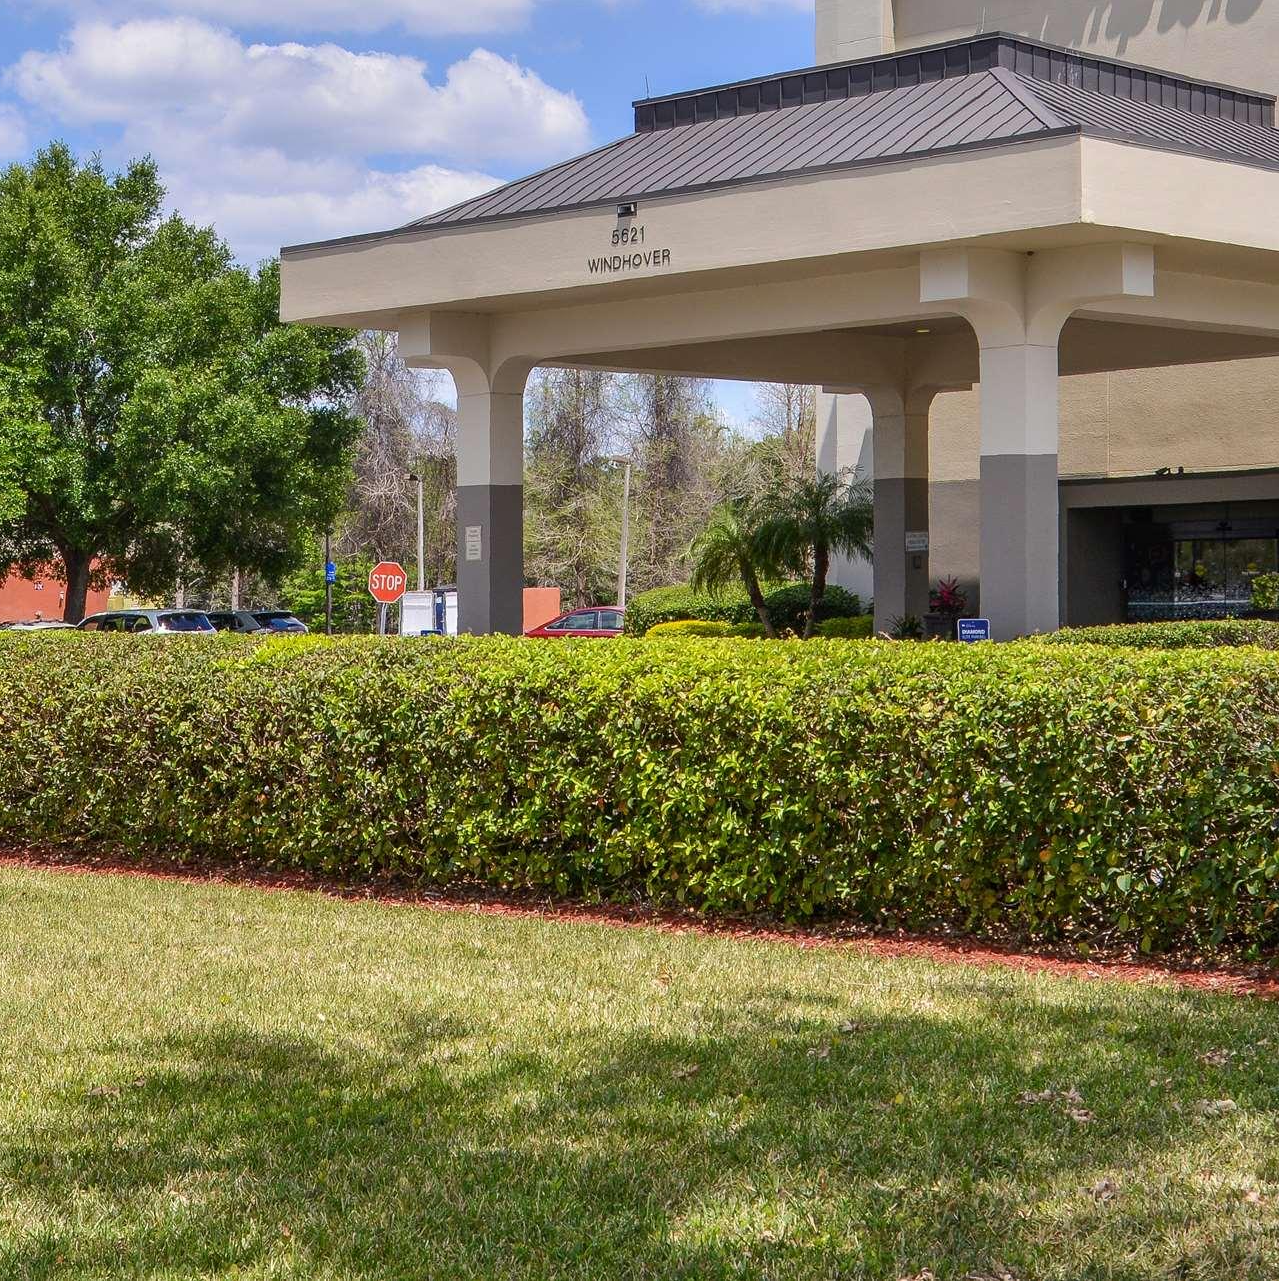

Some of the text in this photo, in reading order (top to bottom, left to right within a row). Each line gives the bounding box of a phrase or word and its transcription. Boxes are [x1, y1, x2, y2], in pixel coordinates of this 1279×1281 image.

[611, 225, 646, 245] 5621
[588, 248, 671, 274] WINDHOVER
[371, 573, 403, 591] STOP
